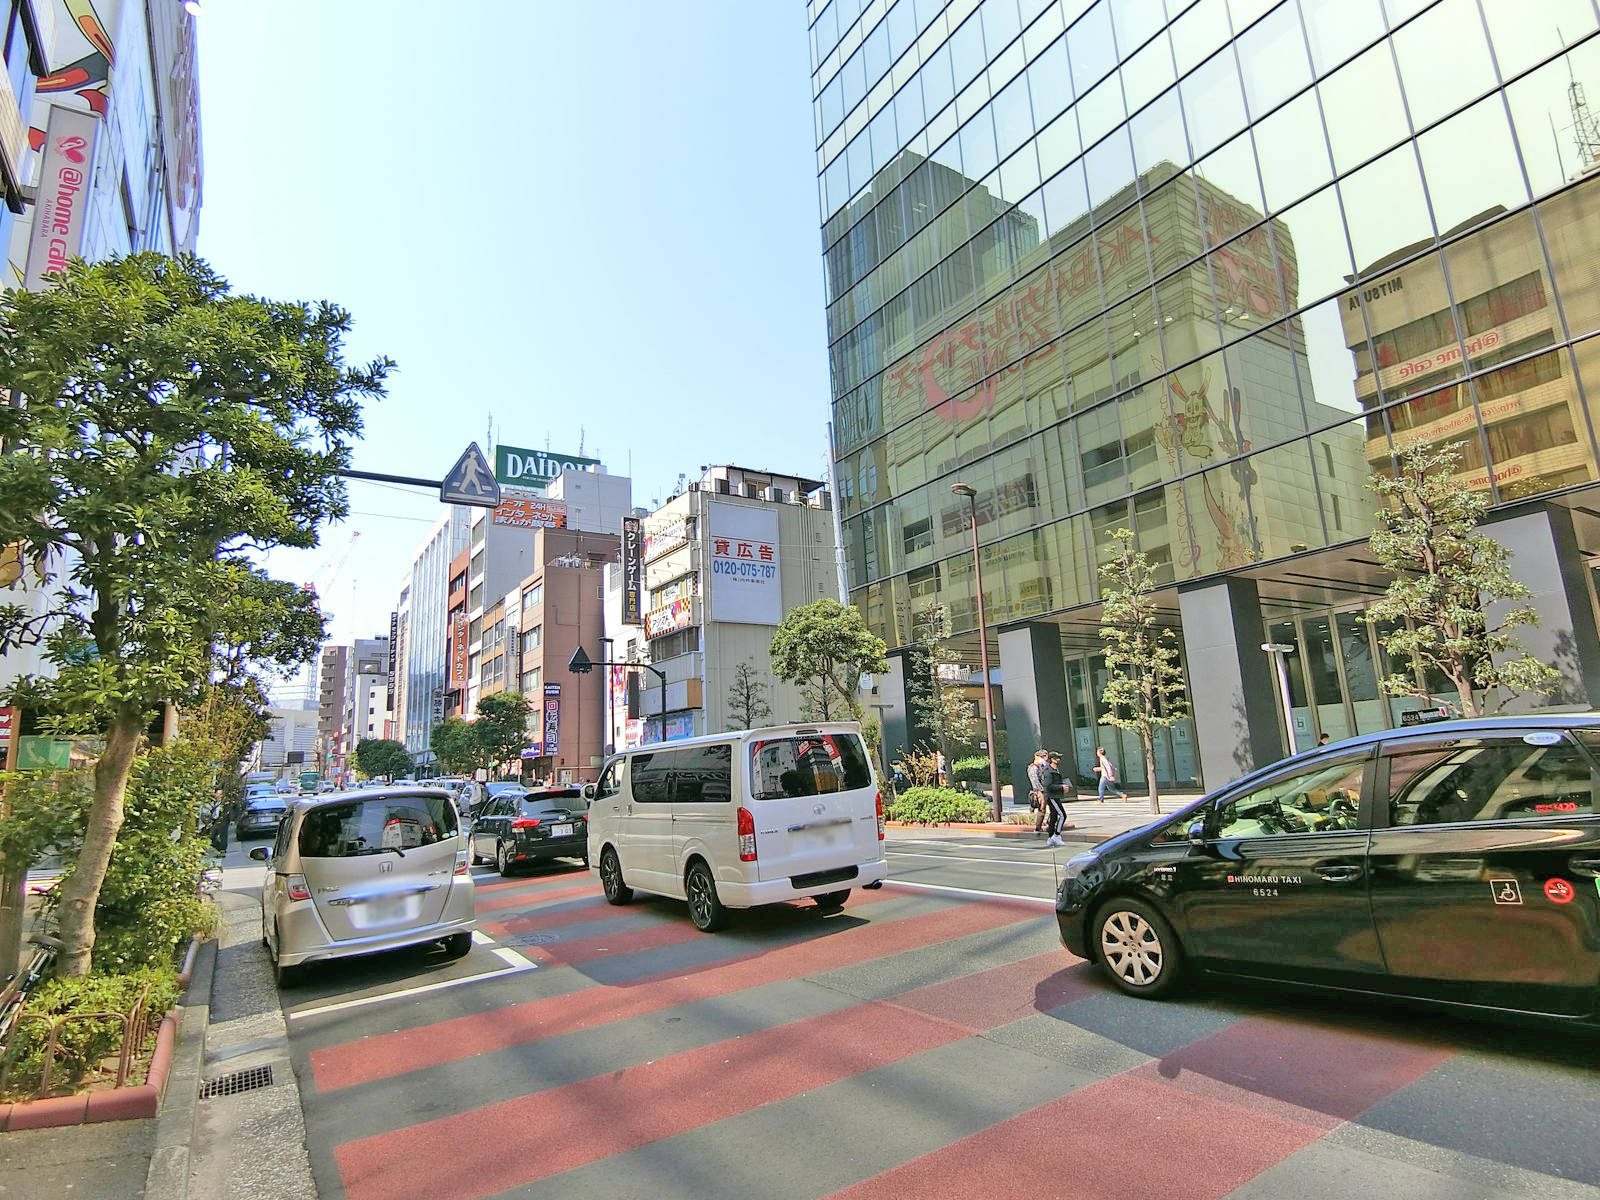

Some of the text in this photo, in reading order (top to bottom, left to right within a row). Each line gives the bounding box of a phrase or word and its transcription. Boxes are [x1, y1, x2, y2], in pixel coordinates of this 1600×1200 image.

[51, 167, 83, 236] @home
[40, 198, 53, 238] AKIHABARA
[713, 560, 776, 579] 0120-075-787
[1402, 714, 1419, 722] 6524
[1234, 875, 1302, 884] HINOMARU TAXI
[1253, 888, 1279, 897] 6524
